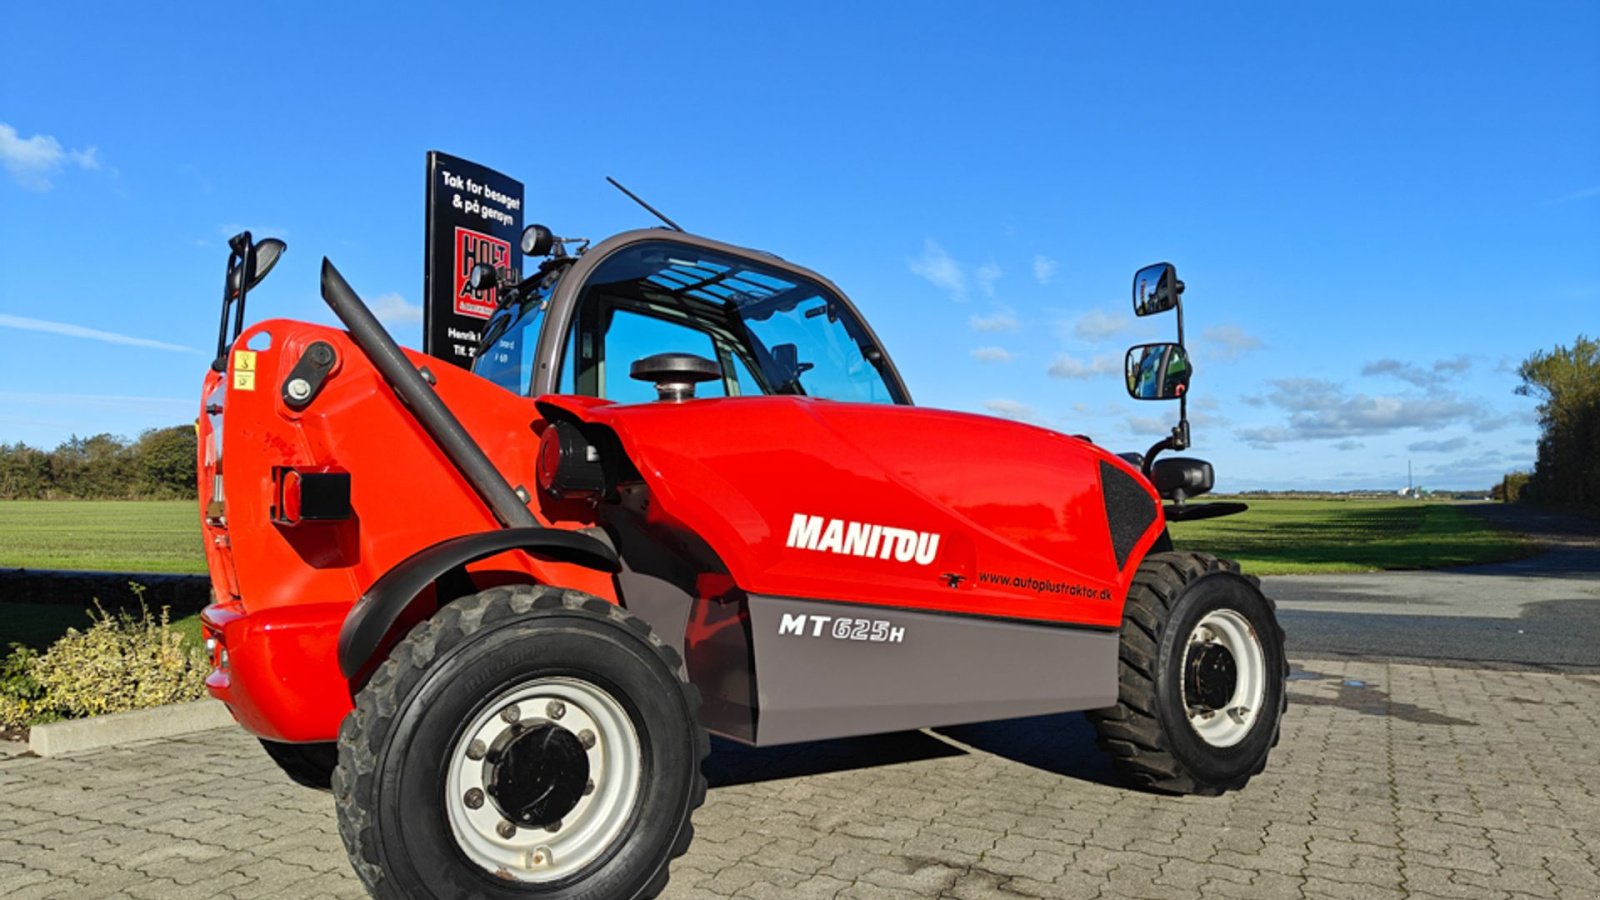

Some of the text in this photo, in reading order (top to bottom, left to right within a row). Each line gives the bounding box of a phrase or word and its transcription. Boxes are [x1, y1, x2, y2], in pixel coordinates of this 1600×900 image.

[442, 170, 520, 210] Tak for besøget
[452, 194, 513, 226] & på gensyn
[447, 327, 476, 341] Henrik
[785, 513, 941, 566] MANITOU
[978, 572, 1112, 601] www.autoplustraktor.dk
